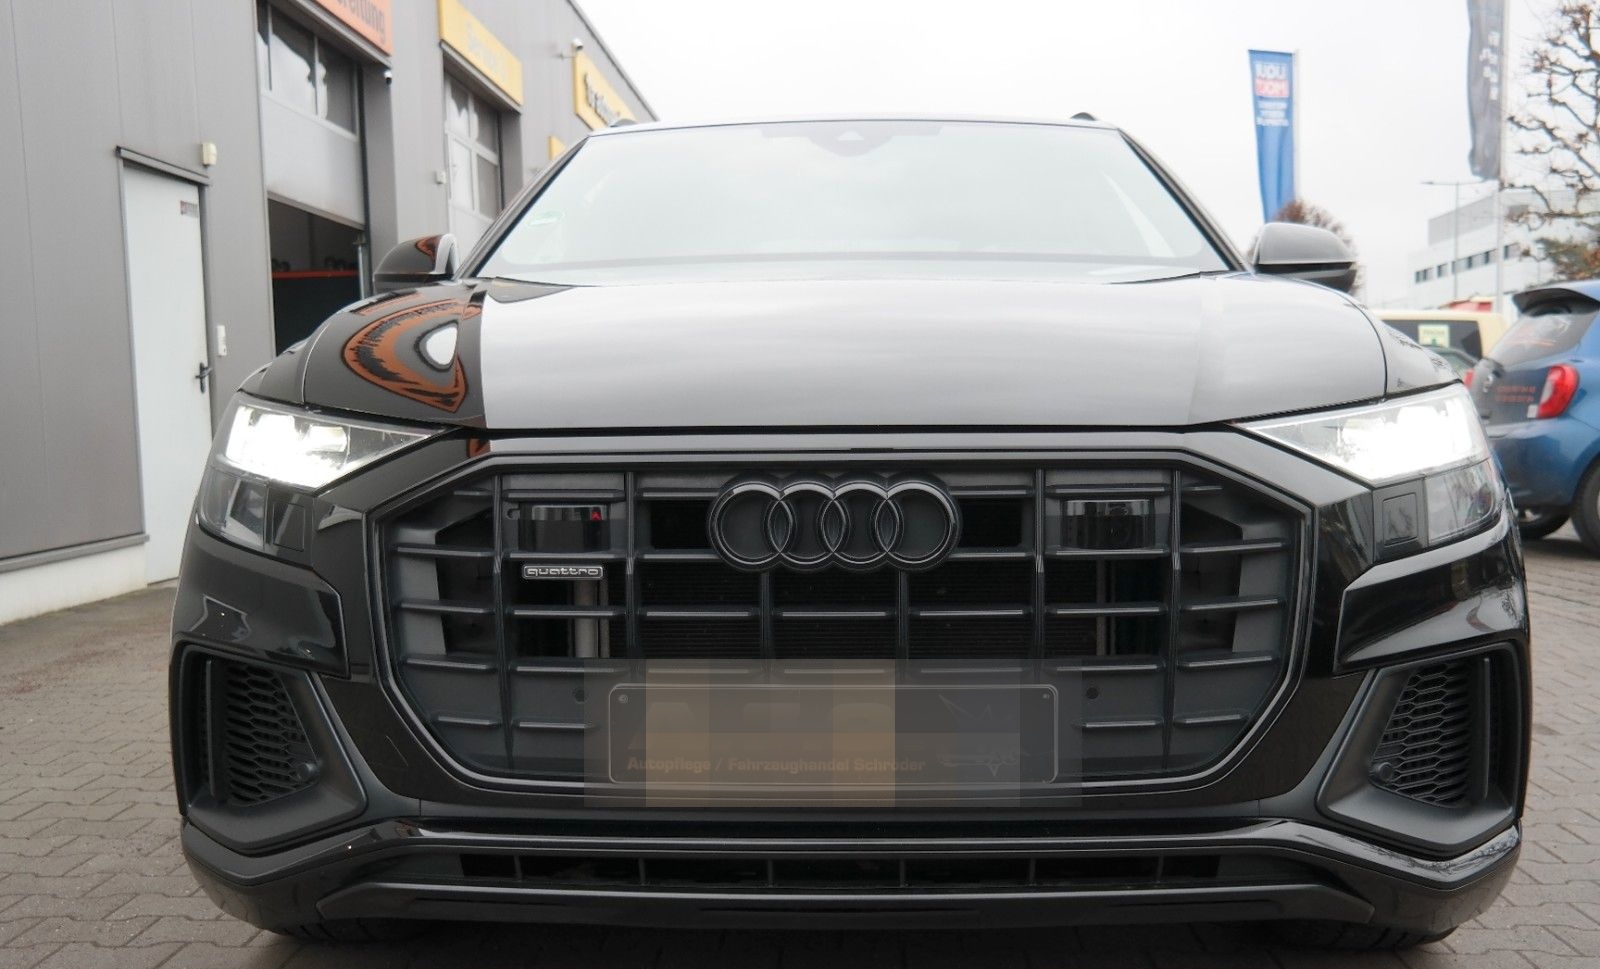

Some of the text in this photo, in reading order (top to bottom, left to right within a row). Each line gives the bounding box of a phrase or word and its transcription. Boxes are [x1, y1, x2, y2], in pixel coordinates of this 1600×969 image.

[526, 567, 599, 576] quattro
[627, 757, 711, 773] Autopflege
[728, 757, 849, 773] Fahrzeughandel
